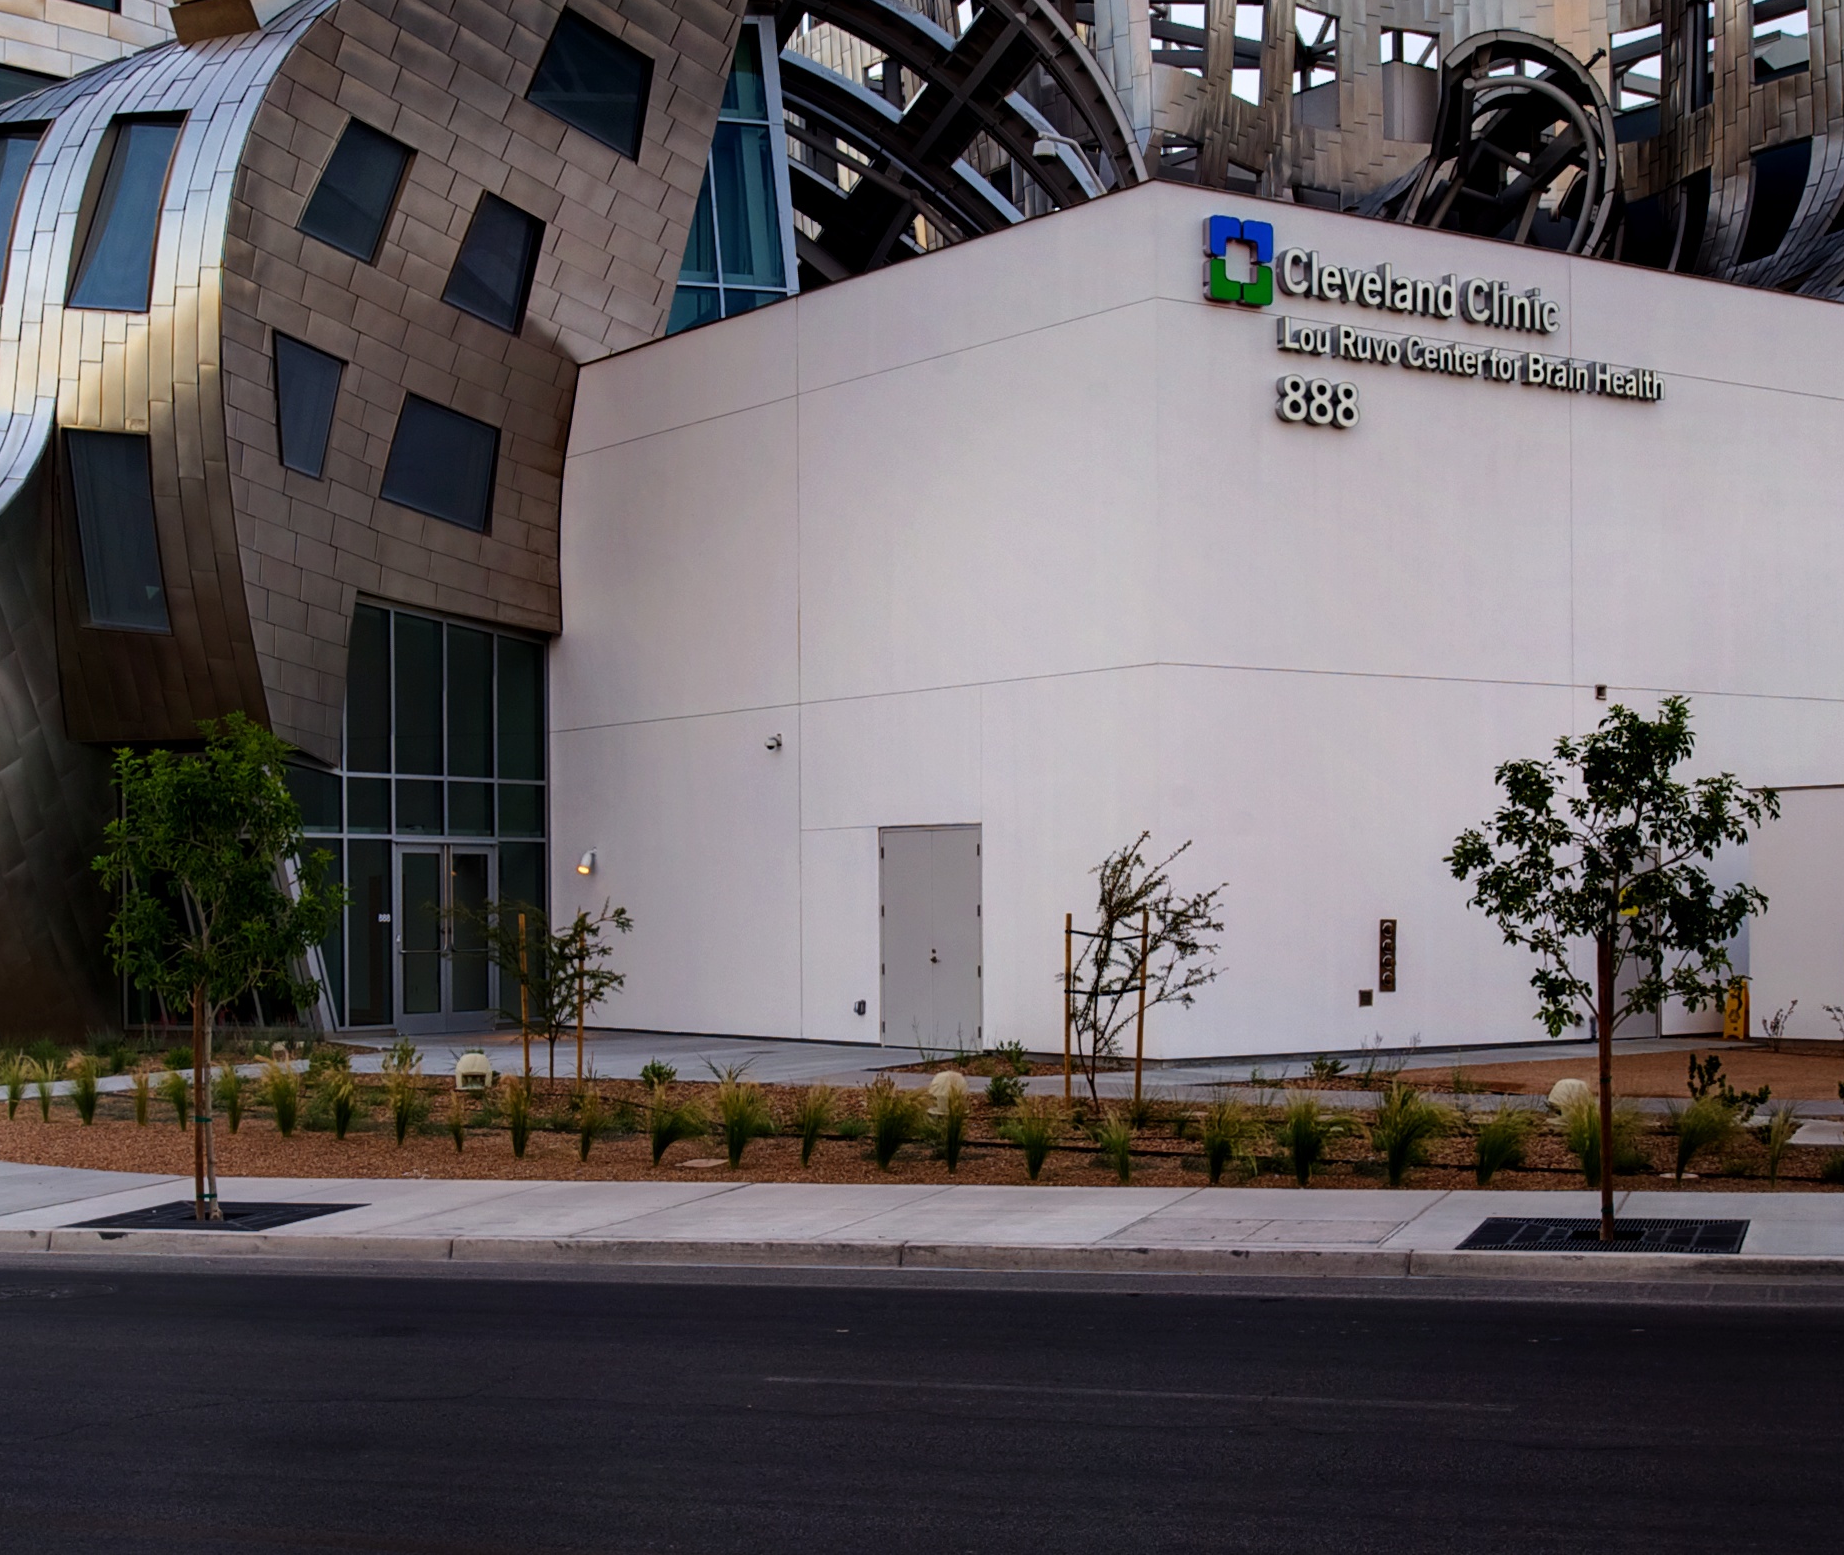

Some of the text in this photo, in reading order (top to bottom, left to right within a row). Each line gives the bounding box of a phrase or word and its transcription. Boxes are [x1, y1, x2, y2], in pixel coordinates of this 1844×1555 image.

[1278, 247, 1560, 333] Cleveland Clinic
[1279, 316, 1666, 401] Lou Ruvo Center for Brain Health
[1277, 374, 1360, 428] 888
[378, 913, 391, 922] 888
